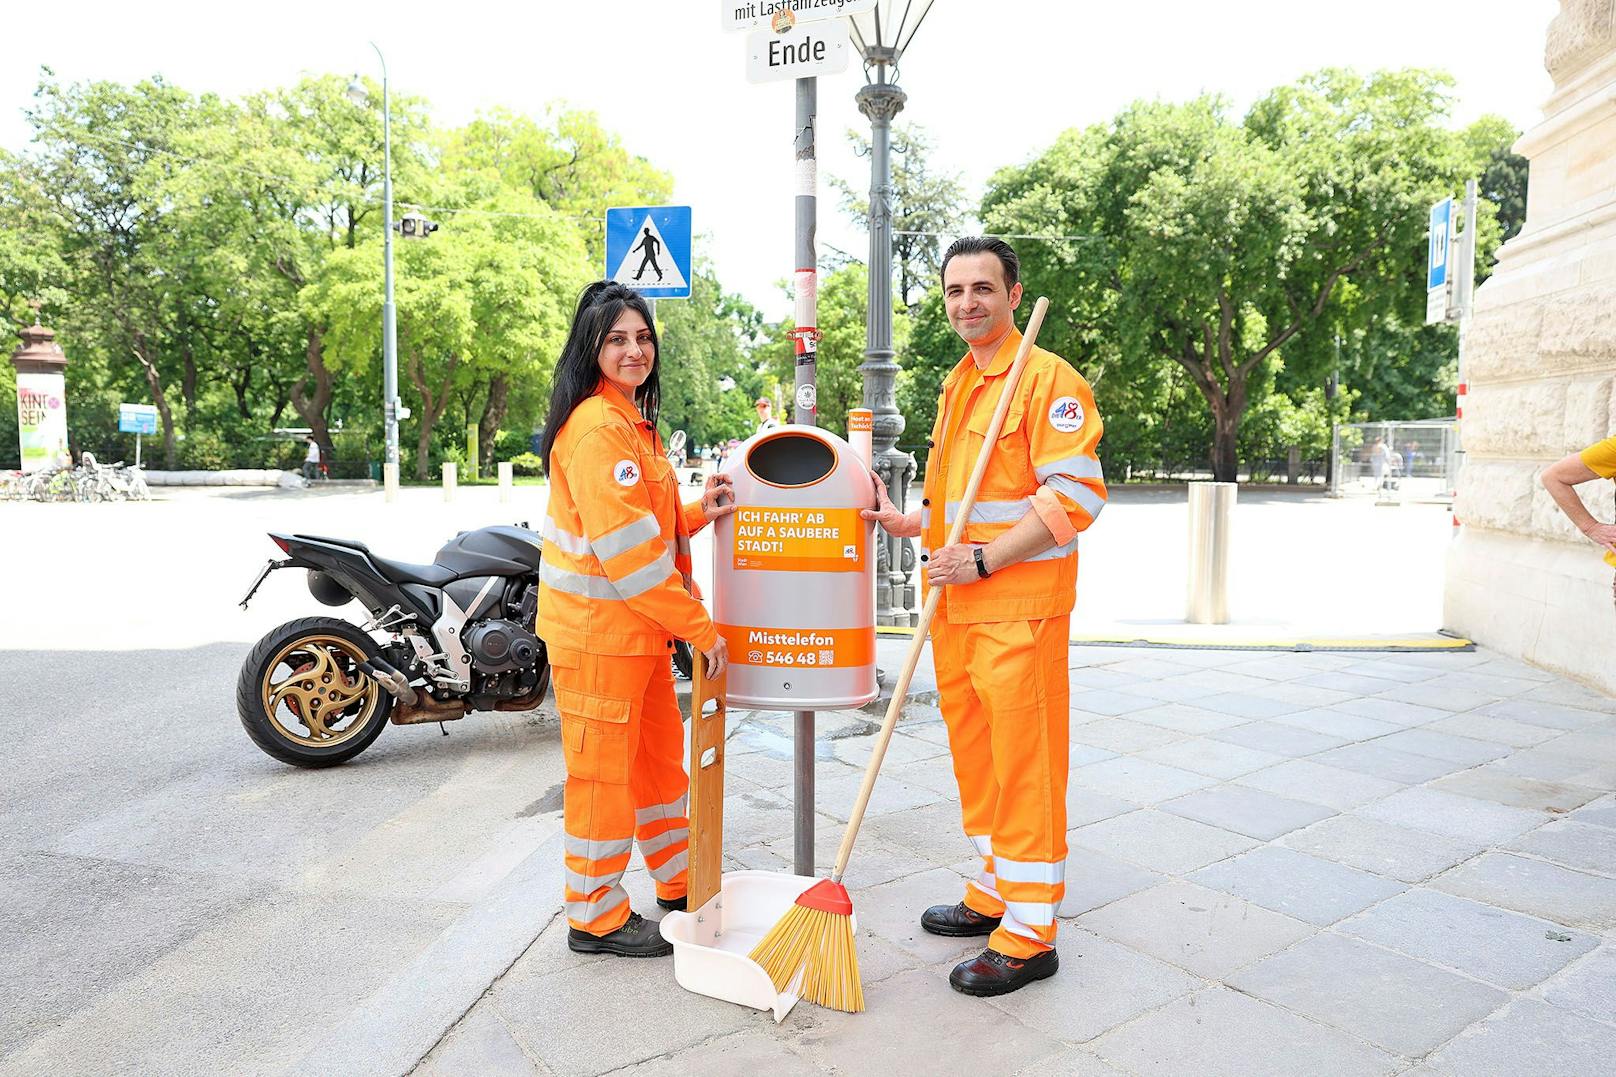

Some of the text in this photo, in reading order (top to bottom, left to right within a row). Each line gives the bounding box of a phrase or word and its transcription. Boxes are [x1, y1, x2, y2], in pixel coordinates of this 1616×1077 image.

[735, 0, 861, 21] mit Lastfahrze
[768, 36, 826, 67] Ende
[737, 511, 760, 522] ICH
[806, 513, 825, 524] AB
[737, 526, 839, 539] AUF A SAUBERE
[737, 540, 784, 552] STADT!
[748, 630, 834, 646] Misttelefon
[766, 651, 816, 665] 546 48
